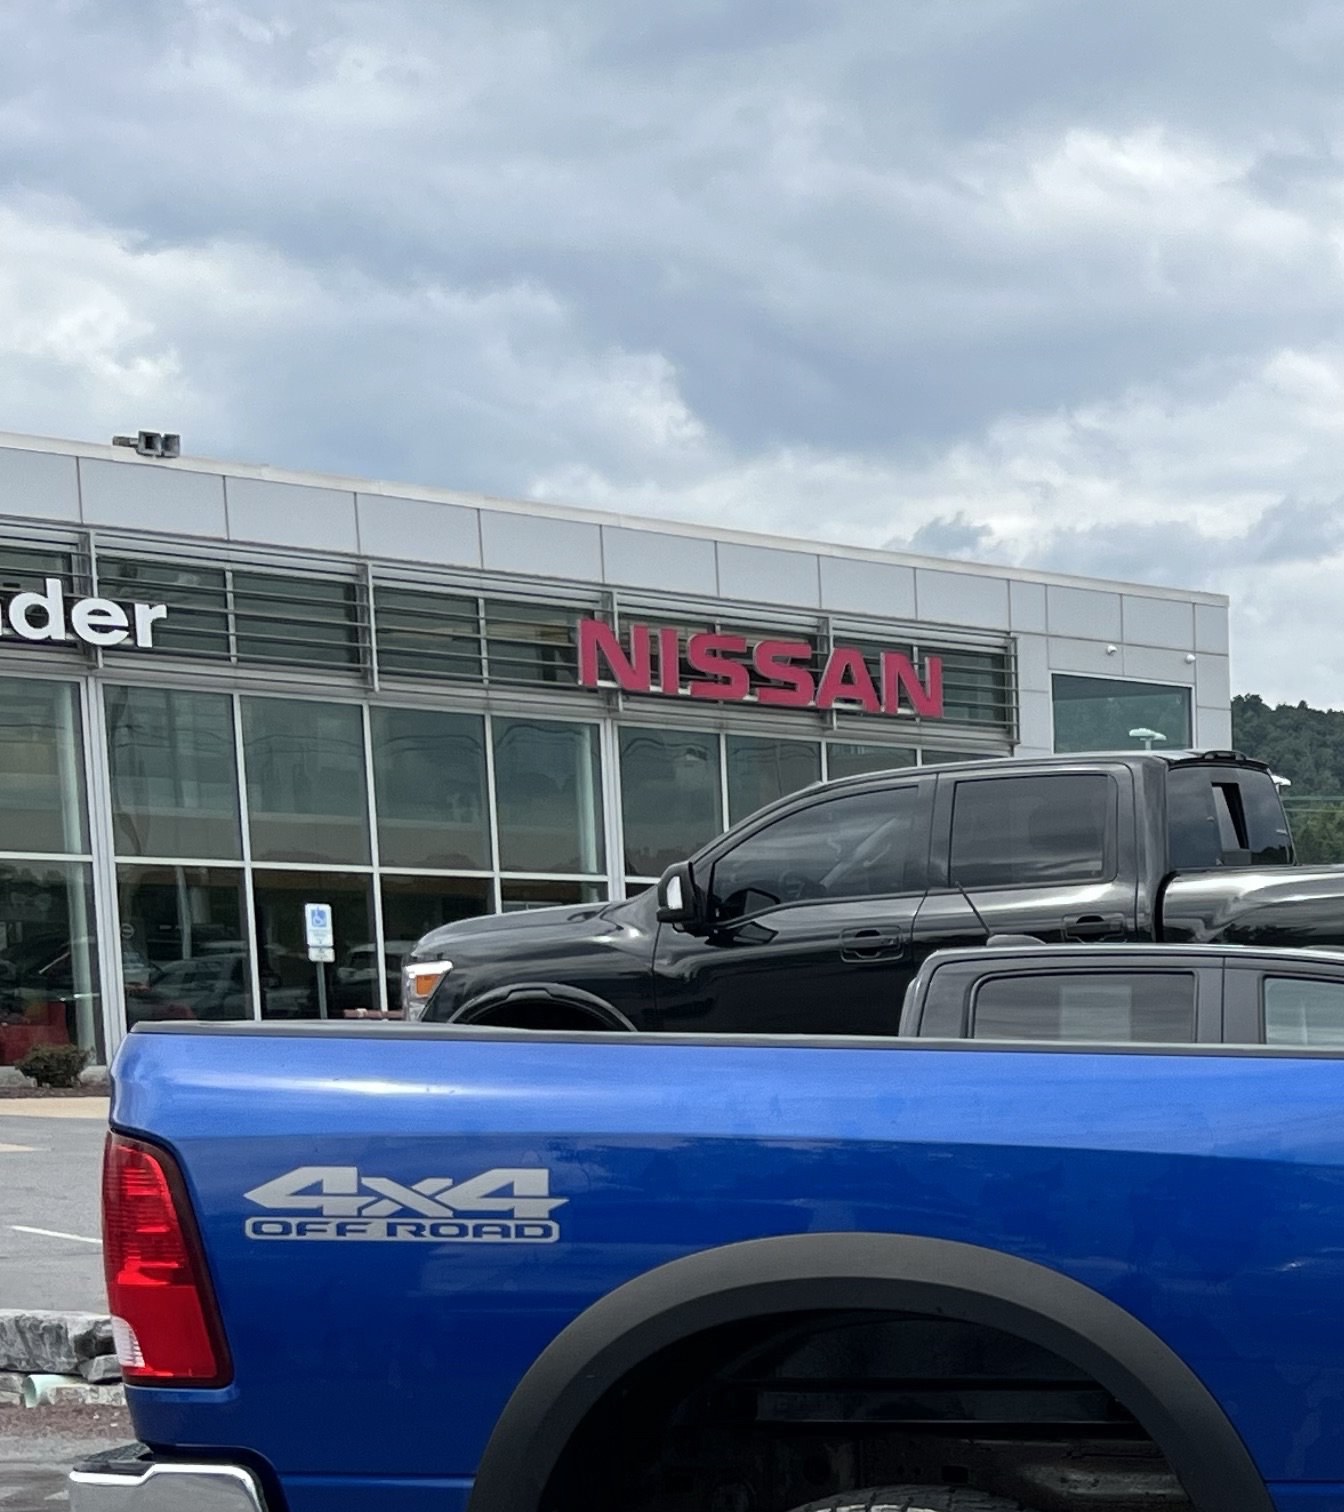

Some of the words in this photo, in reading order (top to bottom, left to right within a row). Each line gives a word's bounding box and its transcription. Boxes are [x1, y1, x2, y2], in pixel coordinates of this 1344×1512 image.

[0, 577, 168, 649] der
[577, 617, 944, 718] NISSAN
[250, 1220, 372, 1238] OFF
[386, 1220, 554, 1240] ROAD
